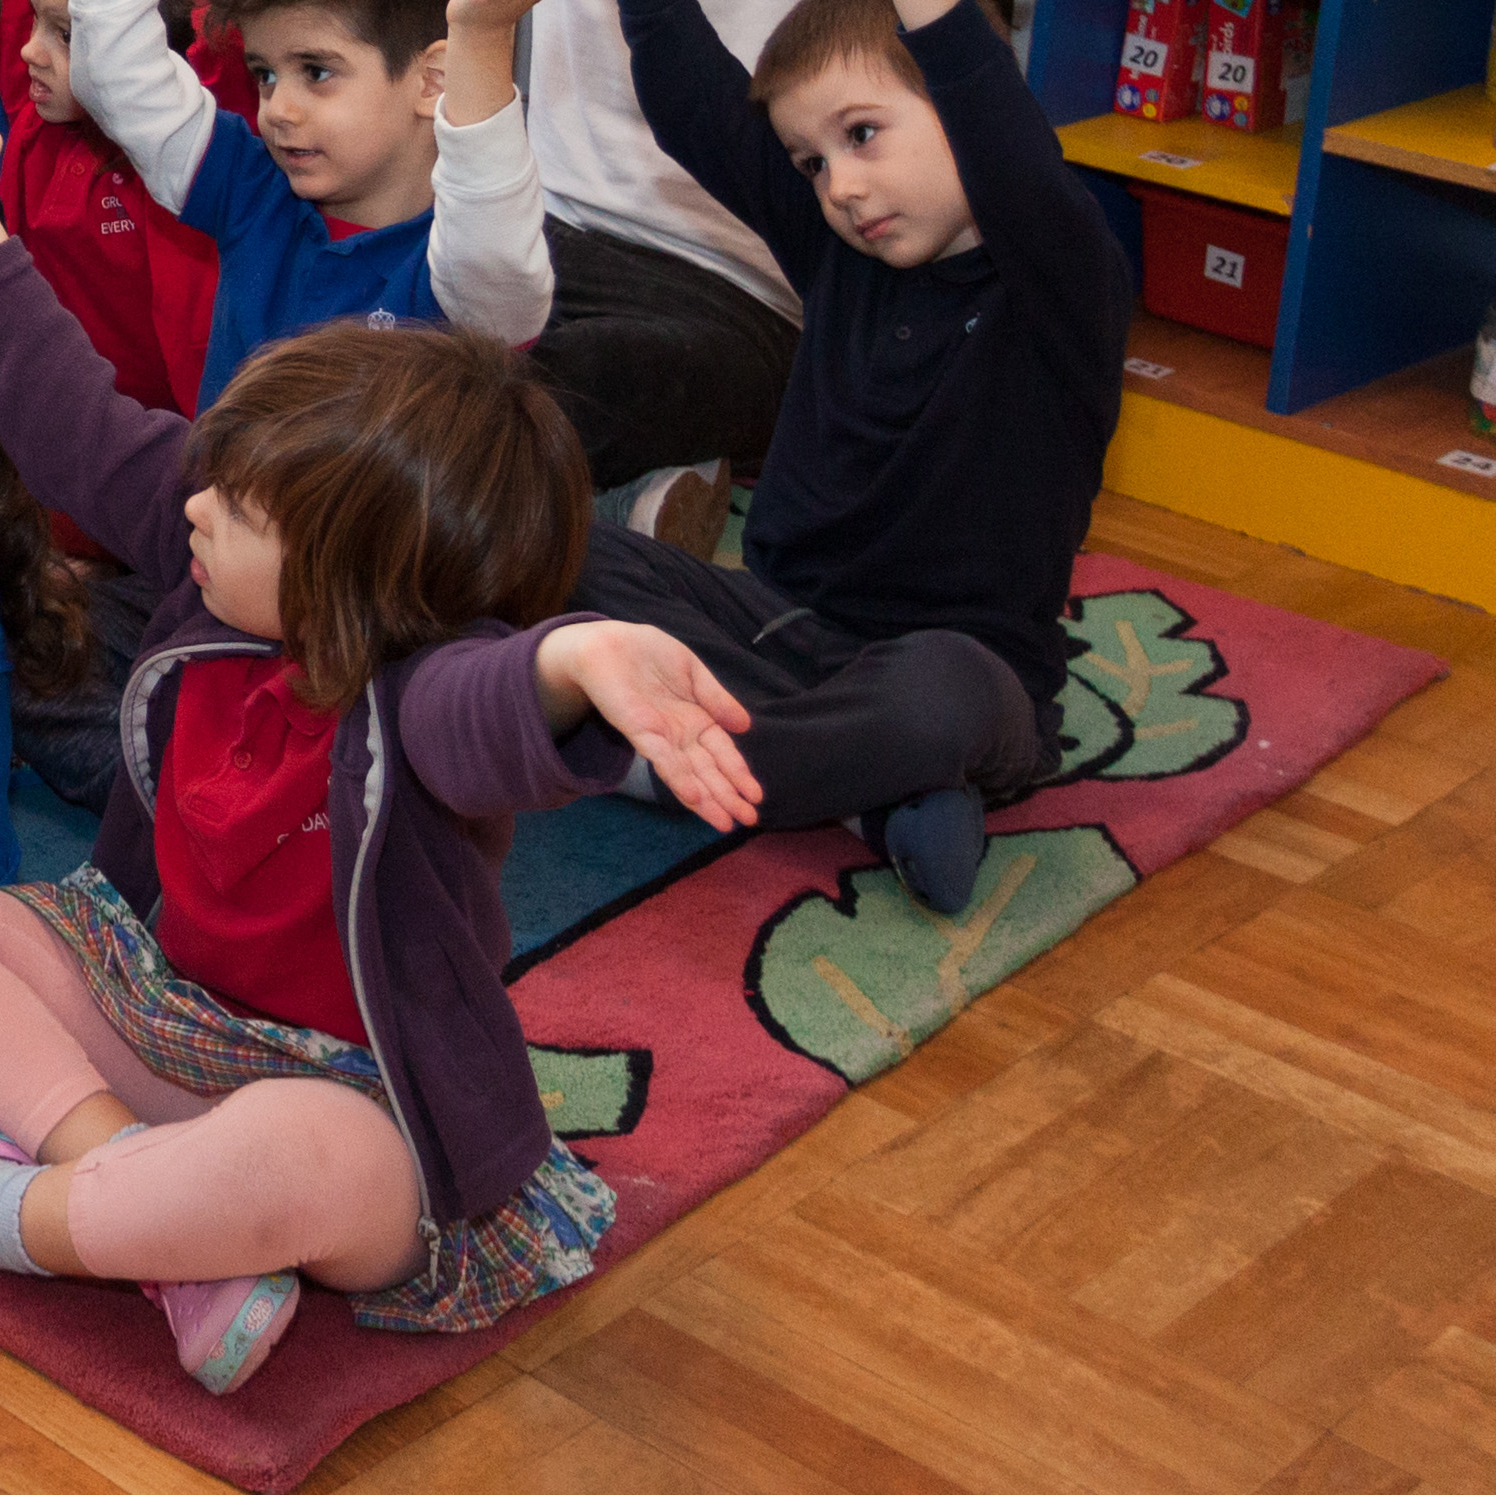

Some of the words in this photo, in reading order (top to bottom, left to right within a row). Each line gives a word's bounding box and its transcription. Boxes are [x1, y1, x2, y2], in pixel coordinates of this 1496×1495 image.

[1129, 45, 1158, 68] 20
[1218, 62, 1247, 84] 20
[101, 219, 135, 234] EVERY
[1212, 256, 1239, 279] 21
